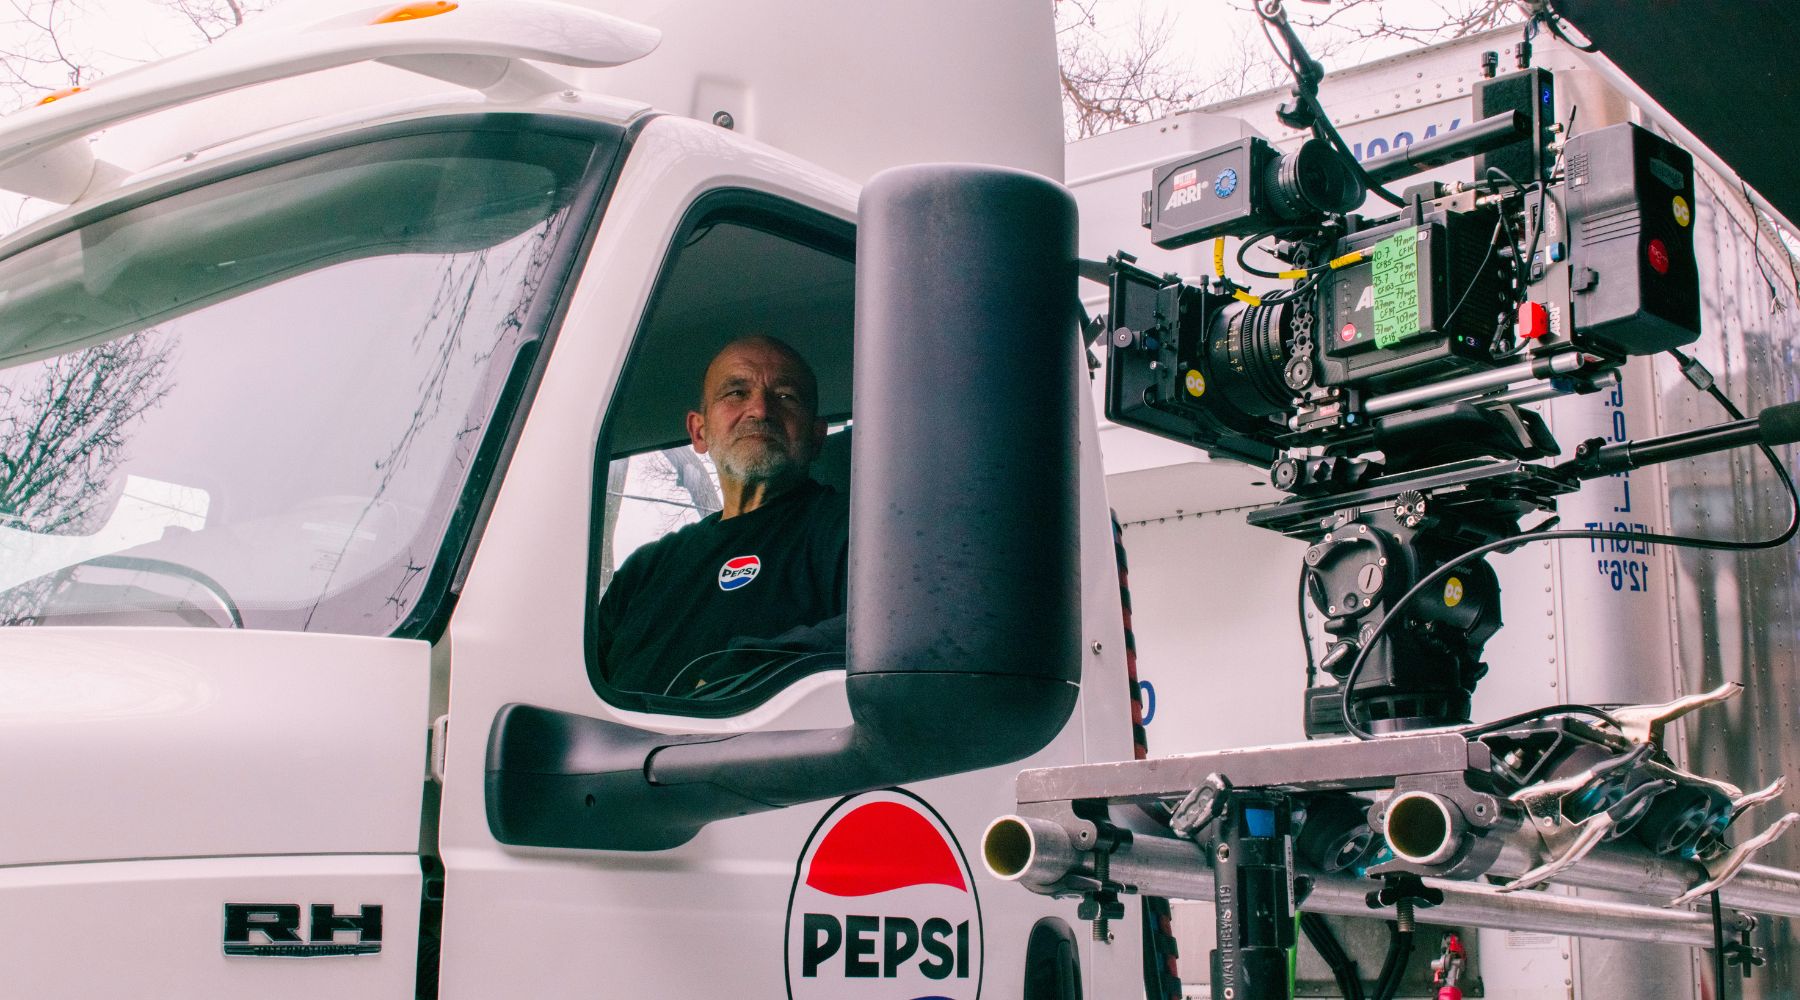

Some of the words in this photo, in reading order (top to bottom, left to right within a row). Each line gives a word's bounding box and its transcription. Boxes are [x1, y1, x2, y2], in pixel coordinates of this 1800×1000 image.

[1164, 182, 1202, 211] ARRI
[721, 566, 758, 579] PEPSI
[223, 903, 383, 944] RH
[802, 913, 970, 980] PEPSI
[1219, 909, 1234, 987] MATTHEWS
